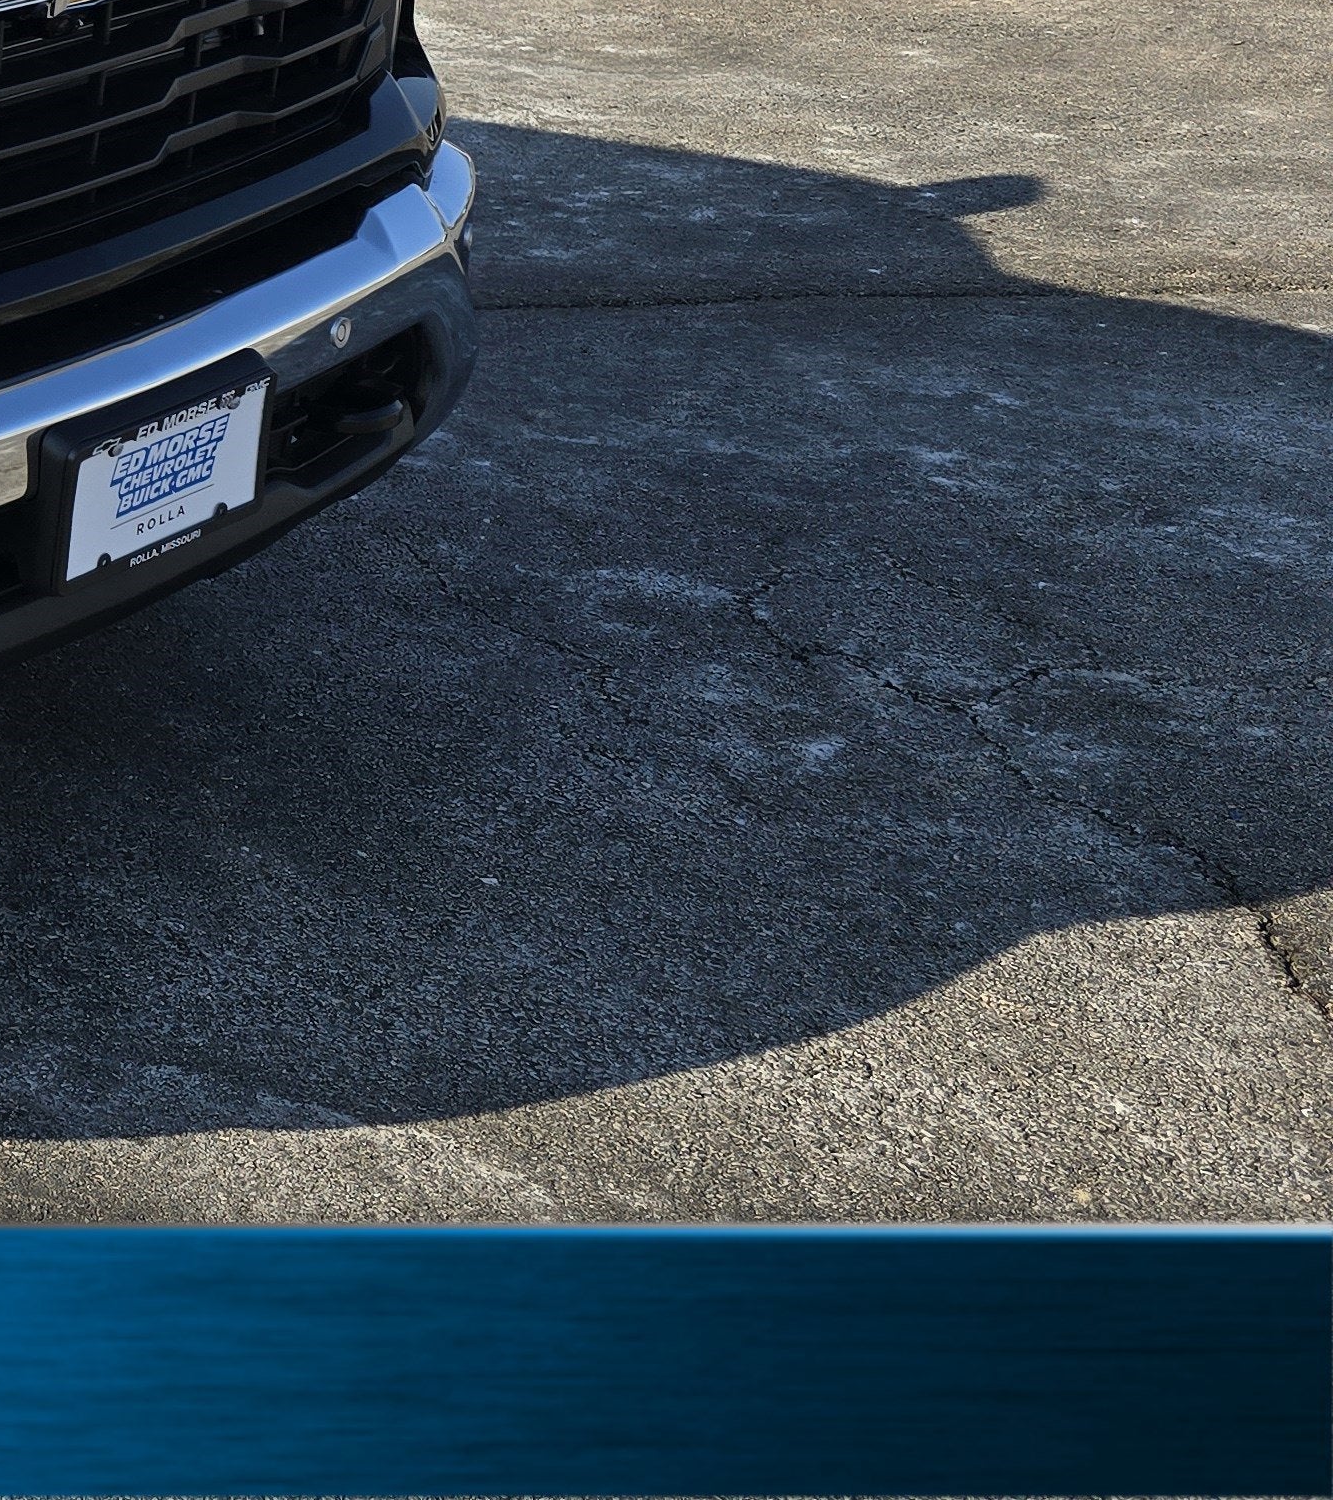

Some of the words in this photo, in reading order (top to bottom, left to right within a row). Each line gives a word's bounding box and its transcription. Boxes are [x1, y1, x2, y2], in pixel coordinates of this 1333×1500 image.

[136, 420, 160, 442] ED
[161, 397, 218, 433] MORSE
[114, 449, 145, 480] ED
[146, 415, 229, 467] MORSE
[120, 441, 219, 495] CHEVROLET
[136, 505, 186, 536] ROLLA
[129, 548, 160, 568] ROLLA,
[160, 528, 202, 554] MISSOURI
